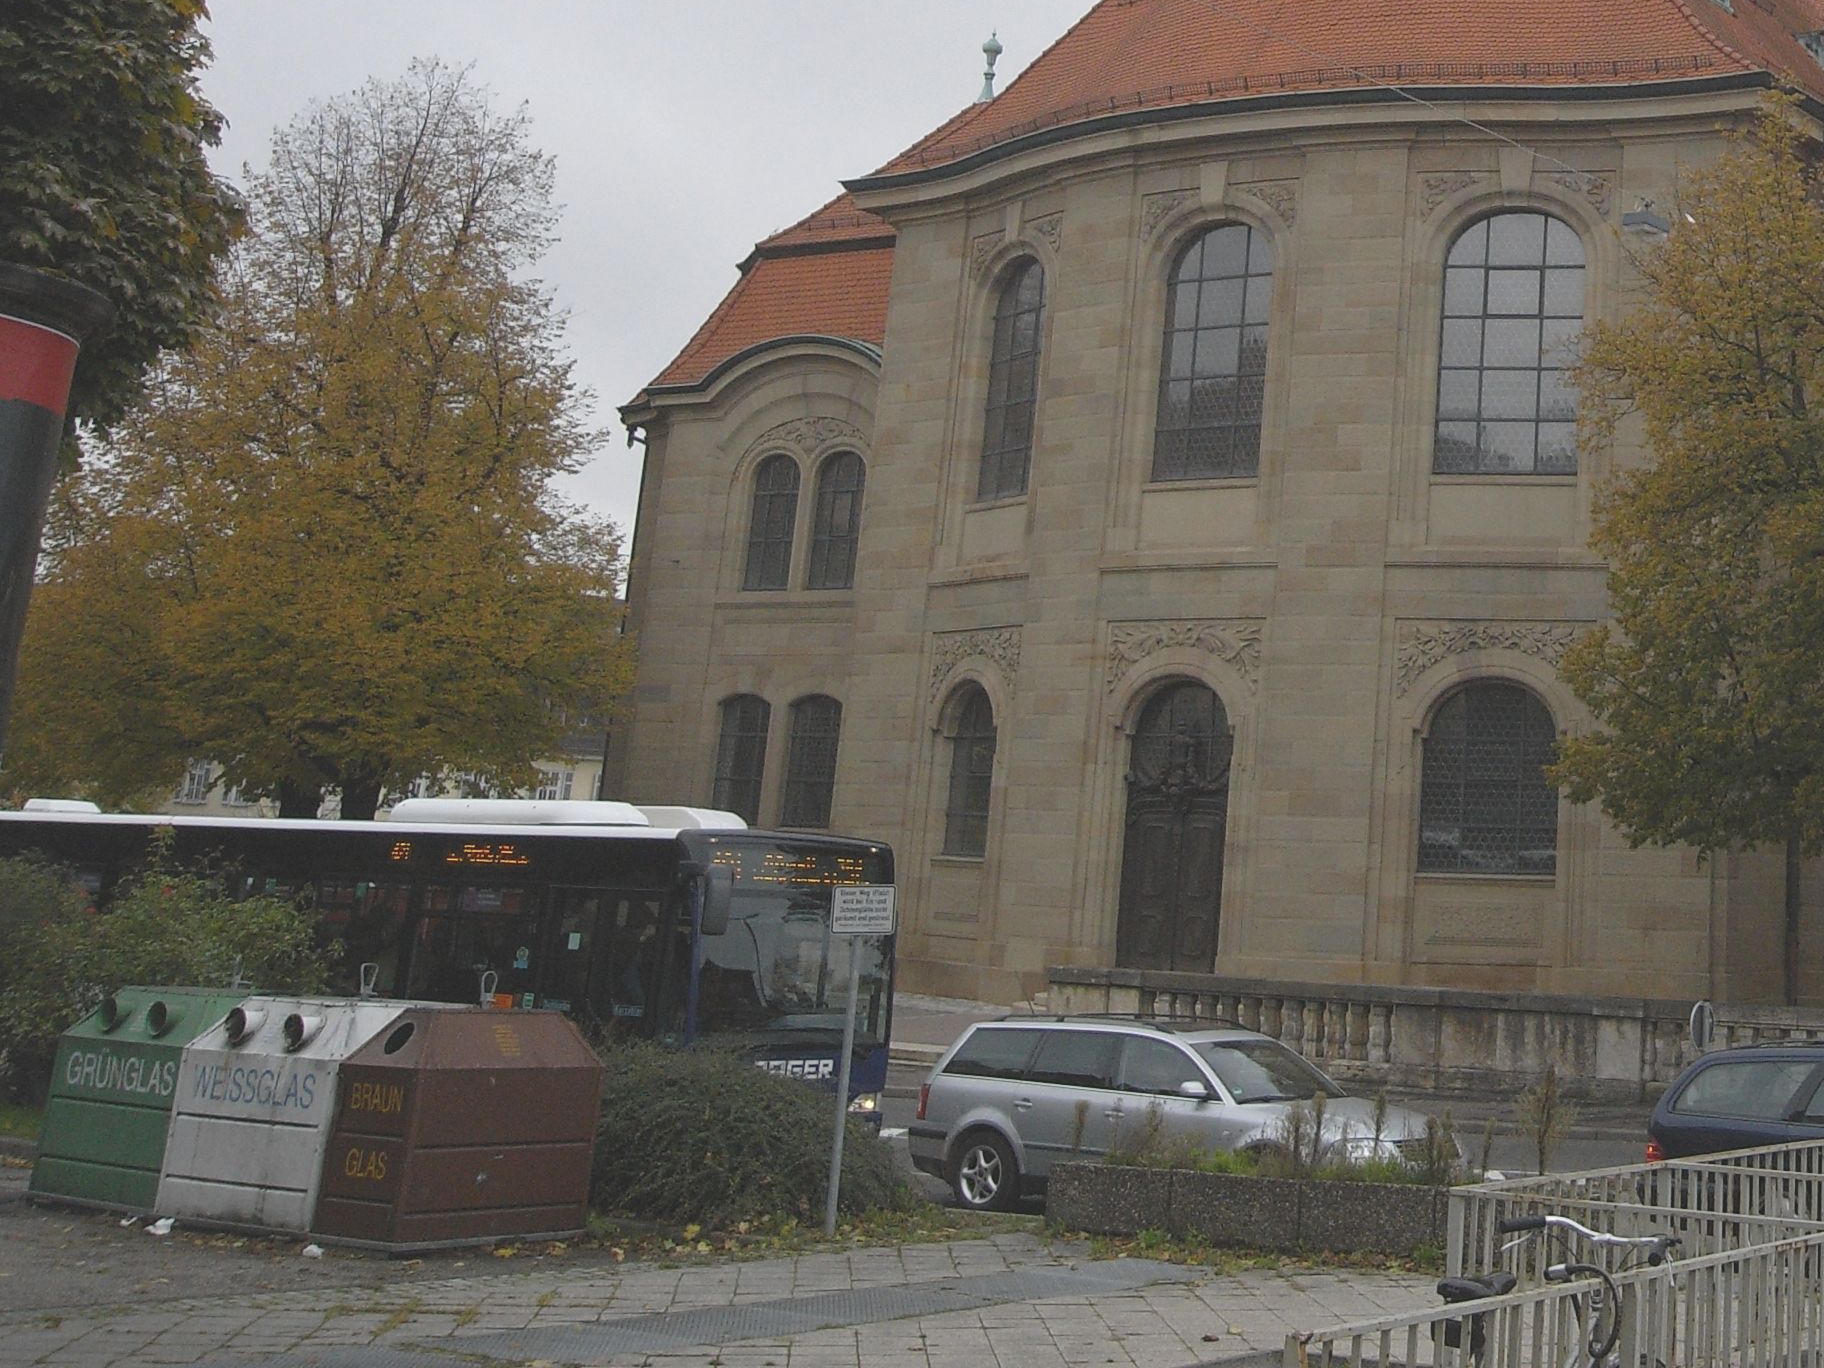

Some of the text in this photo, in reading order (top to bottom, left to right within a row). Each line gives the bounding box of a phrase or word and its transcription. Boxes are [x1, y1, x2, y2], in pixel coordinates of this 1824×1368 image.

[66, 1048, 176, 1097] GRÜNGLAS
[193, 1064, 317, 1109] WEISSGLAS
[351, 1083, 404, 1112] BRAUN
[345, 1147, 387, 1179] GLAS
